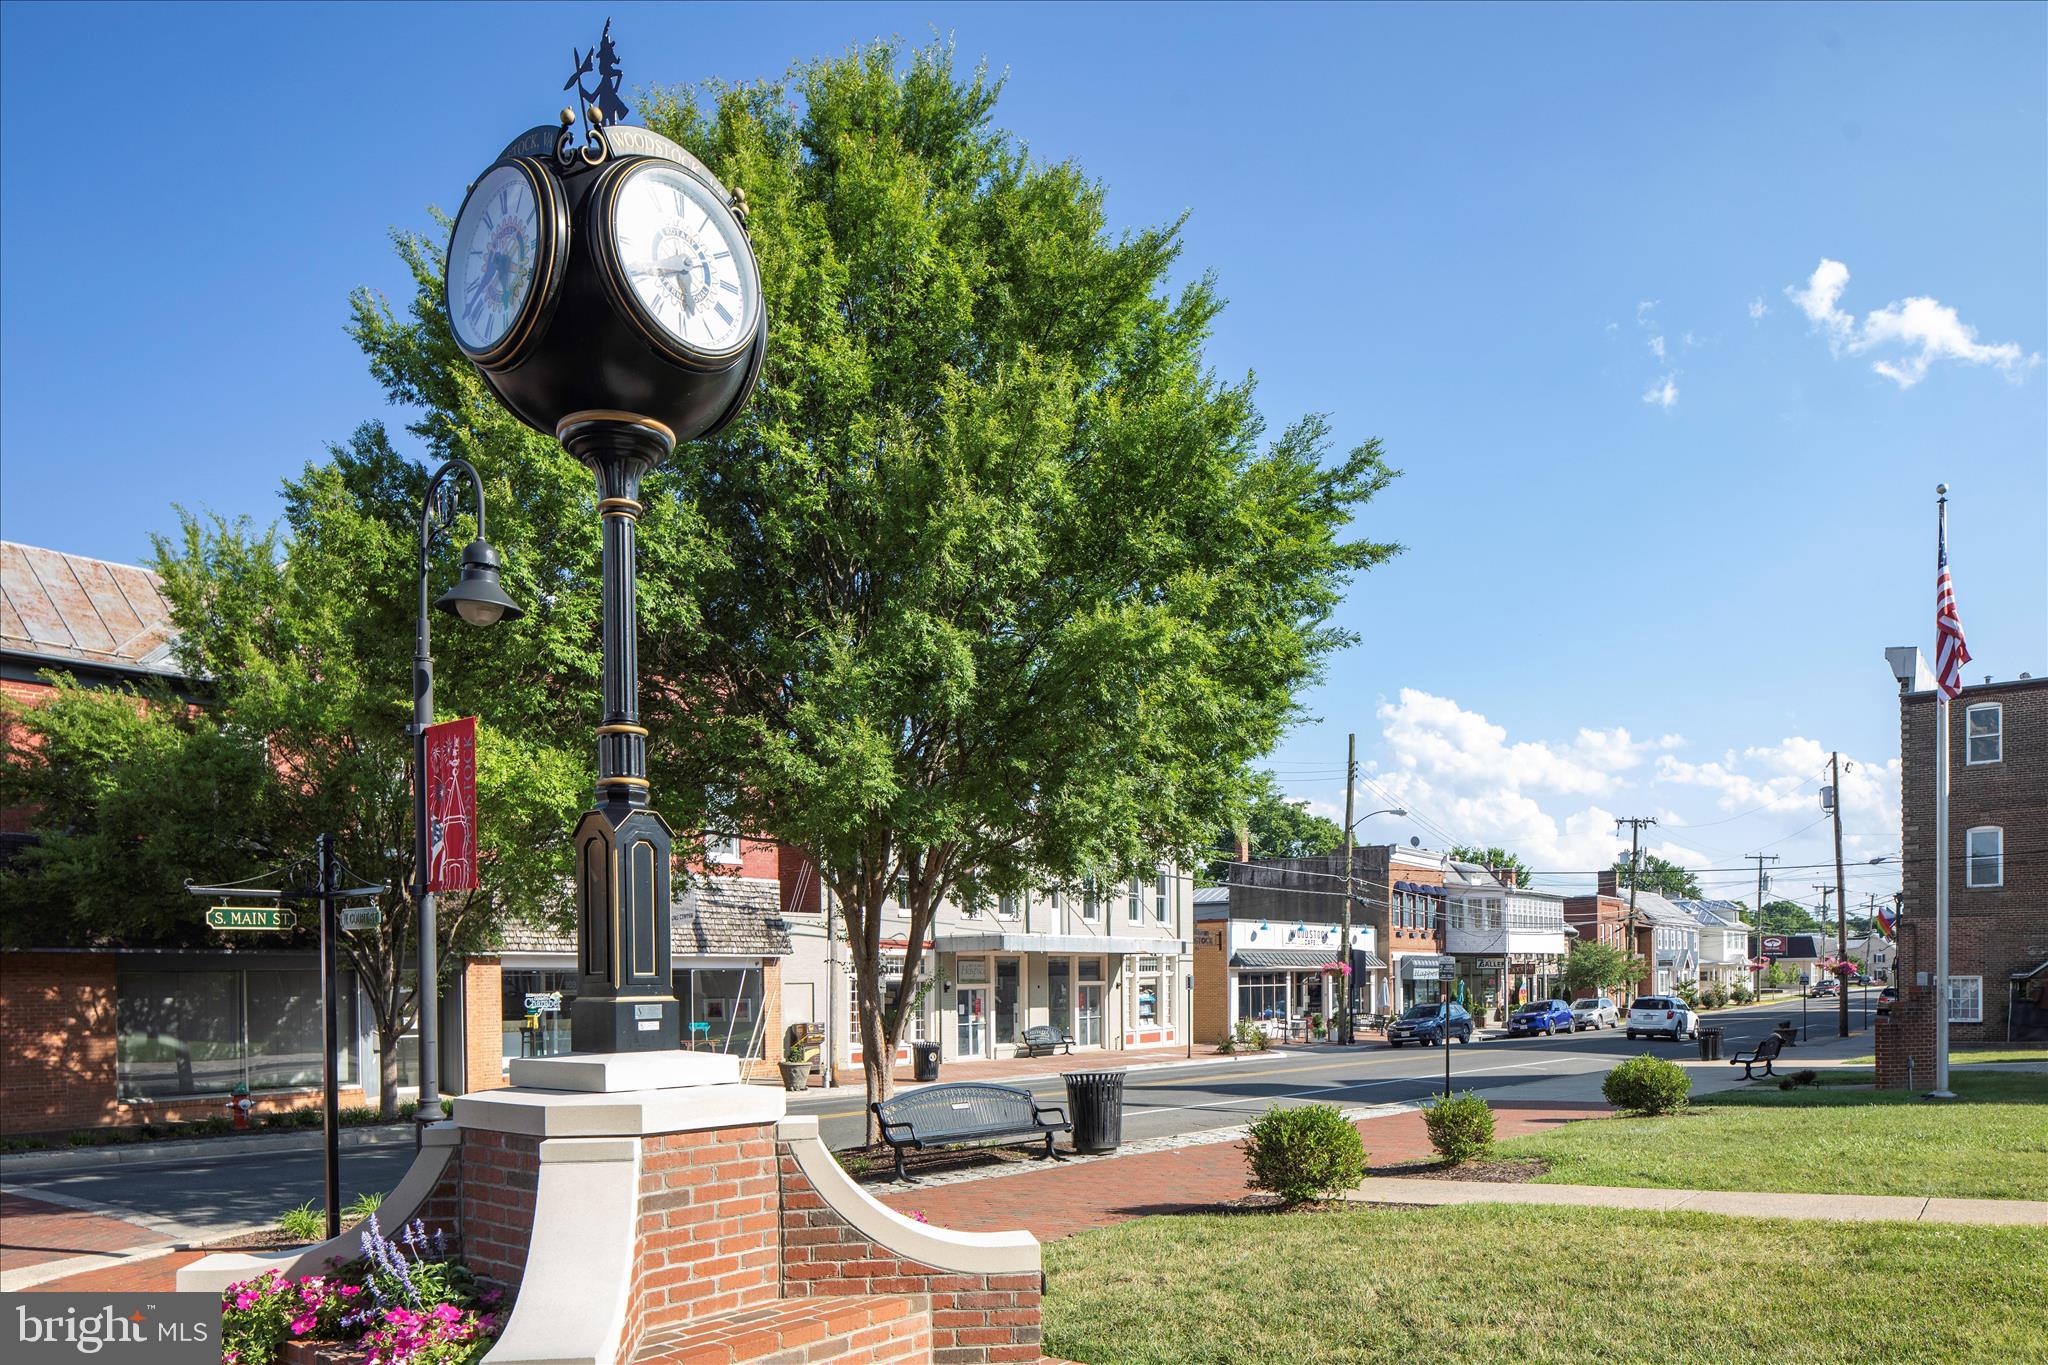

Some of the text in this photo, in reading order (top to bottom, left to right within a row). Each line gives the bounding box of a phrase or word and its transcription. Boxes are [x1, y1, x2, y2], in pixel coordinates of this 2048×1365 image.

[612, 131, 700, 173] WOODSTOCK
[463, 734, 473, 875] WOODSTOCK
[214, 912, 226, 925] S.
[231, 912, 270, 925] MAIN
